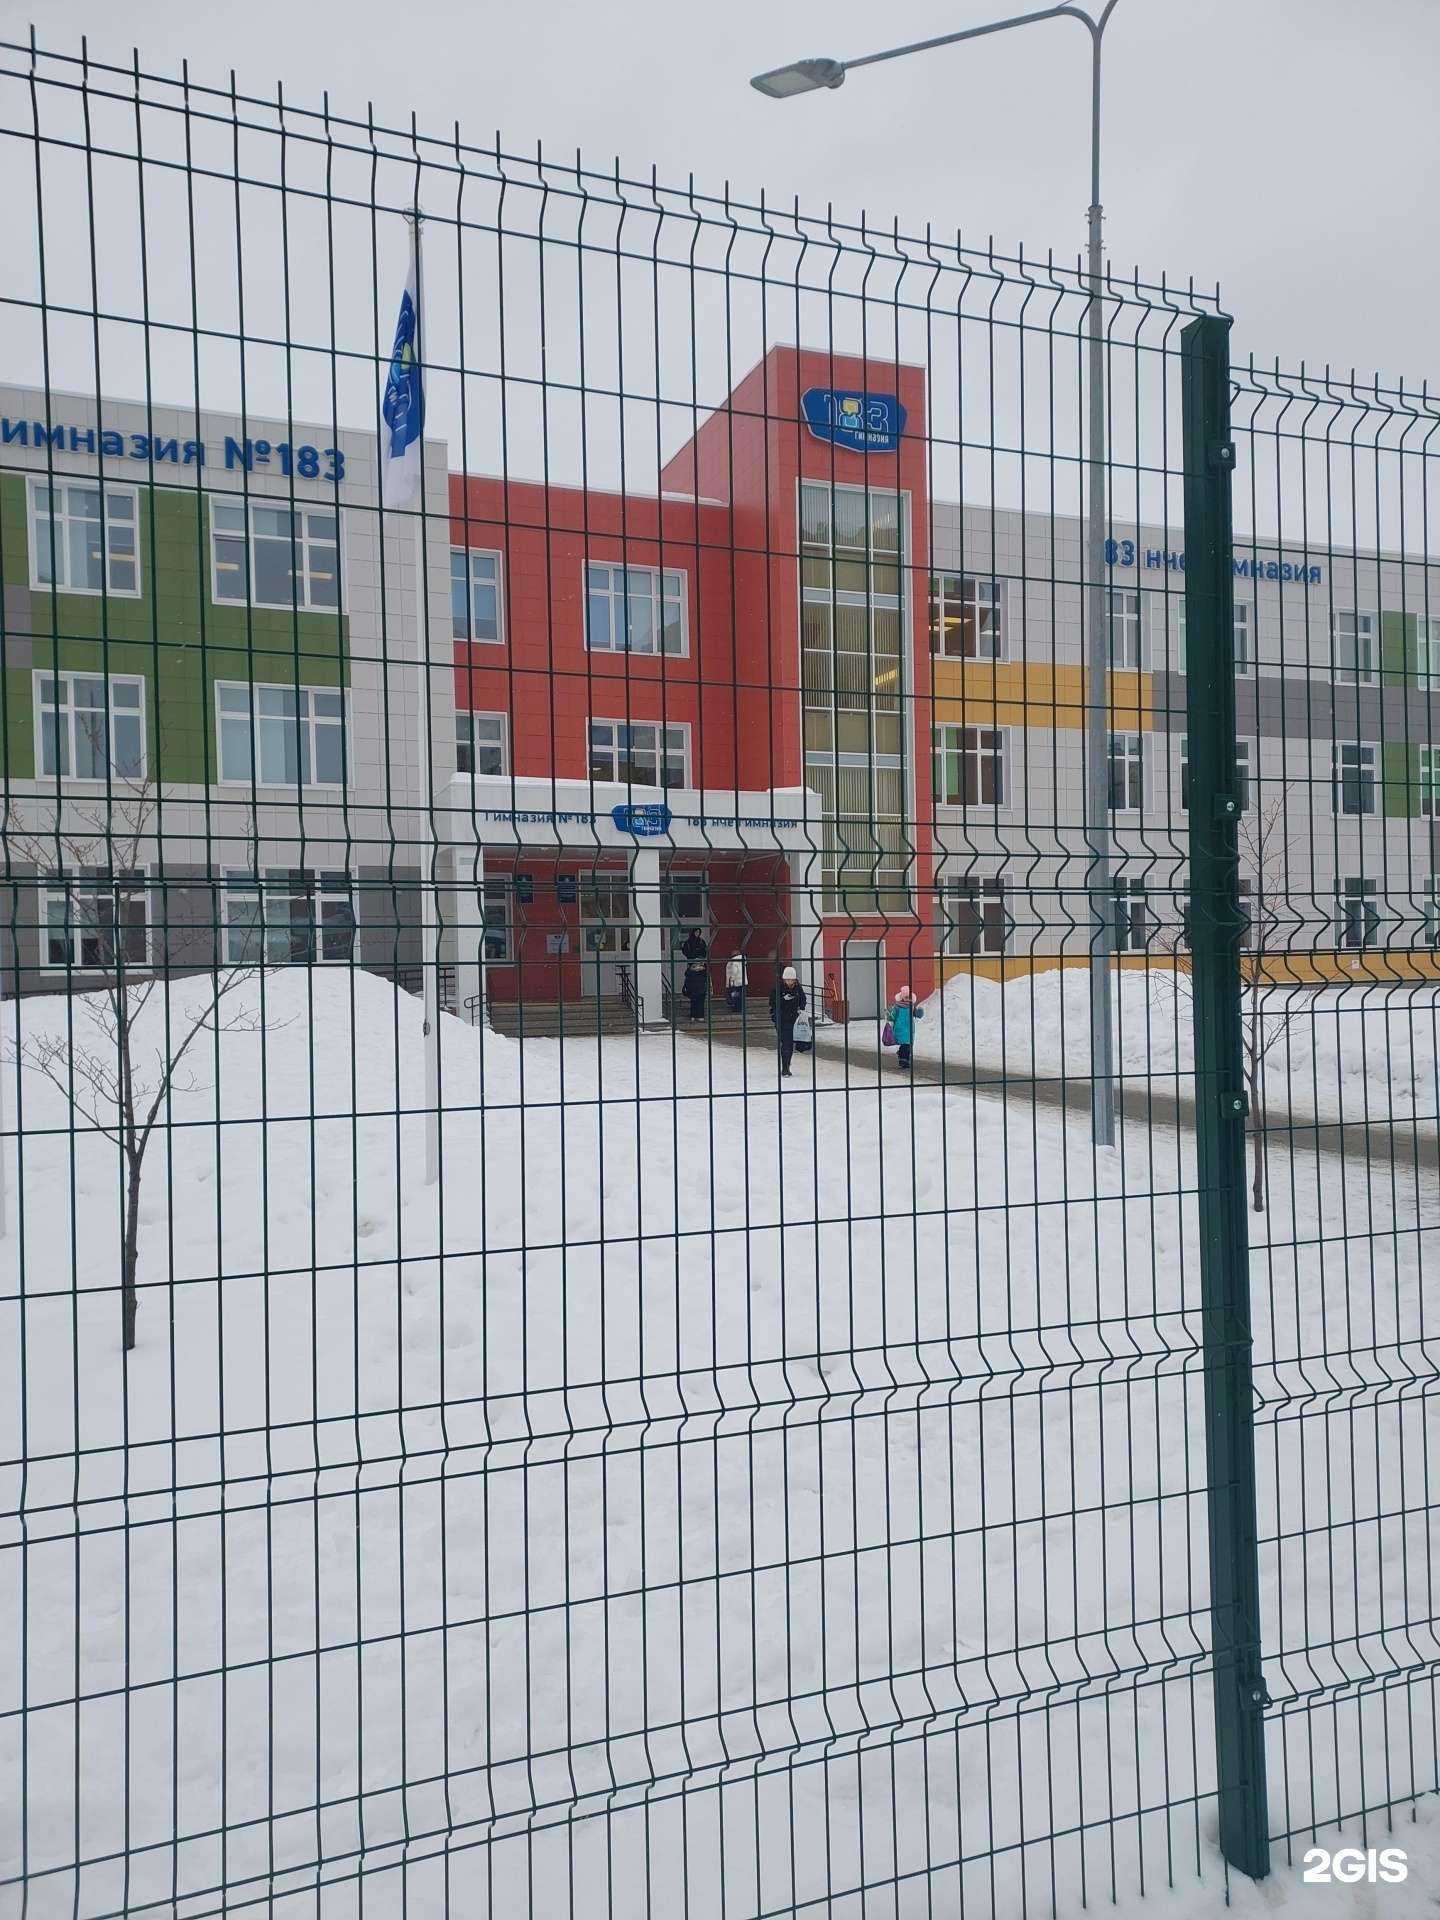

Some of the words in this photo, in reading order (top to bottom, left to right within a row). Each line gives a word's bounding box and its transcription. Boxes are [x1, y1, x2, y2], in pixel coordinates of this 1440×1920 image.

[223, 435, 346, 482] №183
[1104, 538, 1135, 567] 83
[1232, 558, 1322, 584] мназия
